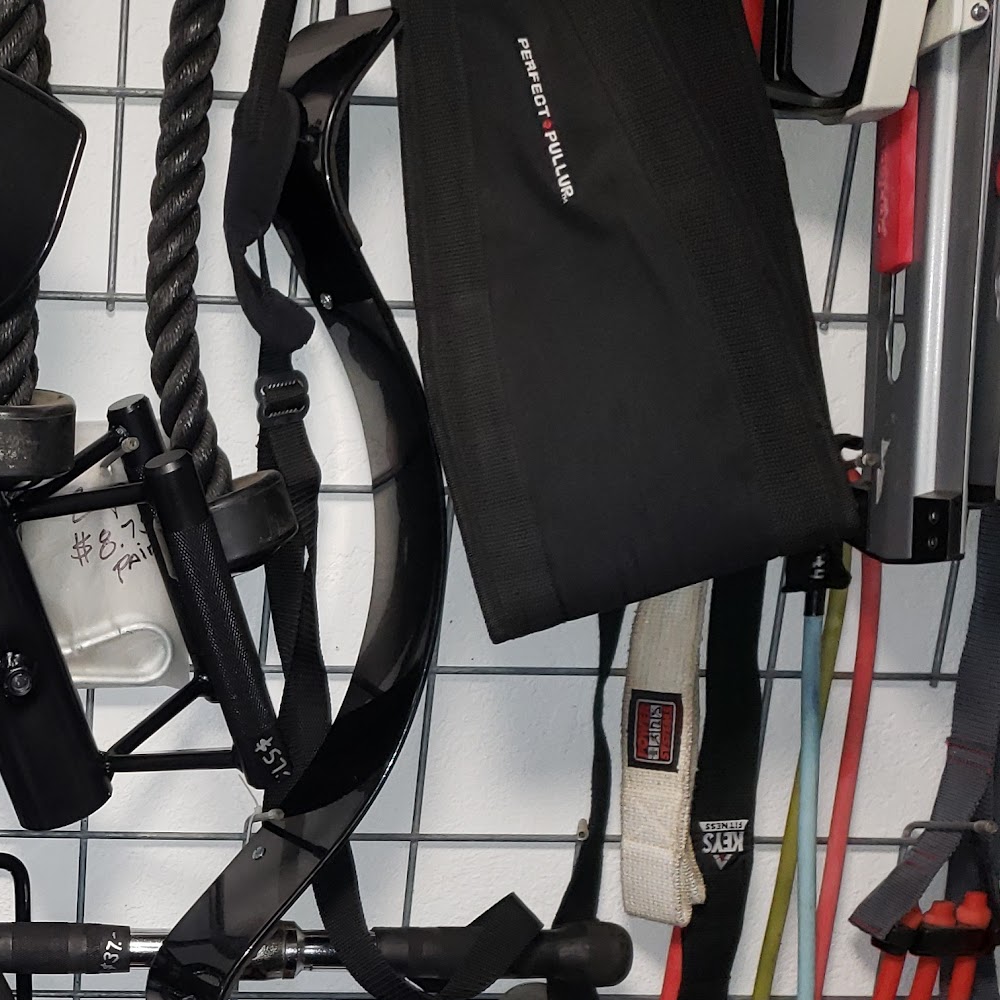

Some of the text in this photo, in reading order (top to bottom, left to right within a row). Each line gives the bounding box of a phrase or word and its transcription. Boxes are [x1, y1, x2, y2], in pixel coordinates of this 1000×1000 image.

[517, 37, 574, 198] PERFECT PULLUP
[71, 518, 148, 567] $8.7
[702, 831, 745, 854] KEYS
[705, 821, 743, 830] FITNESS
